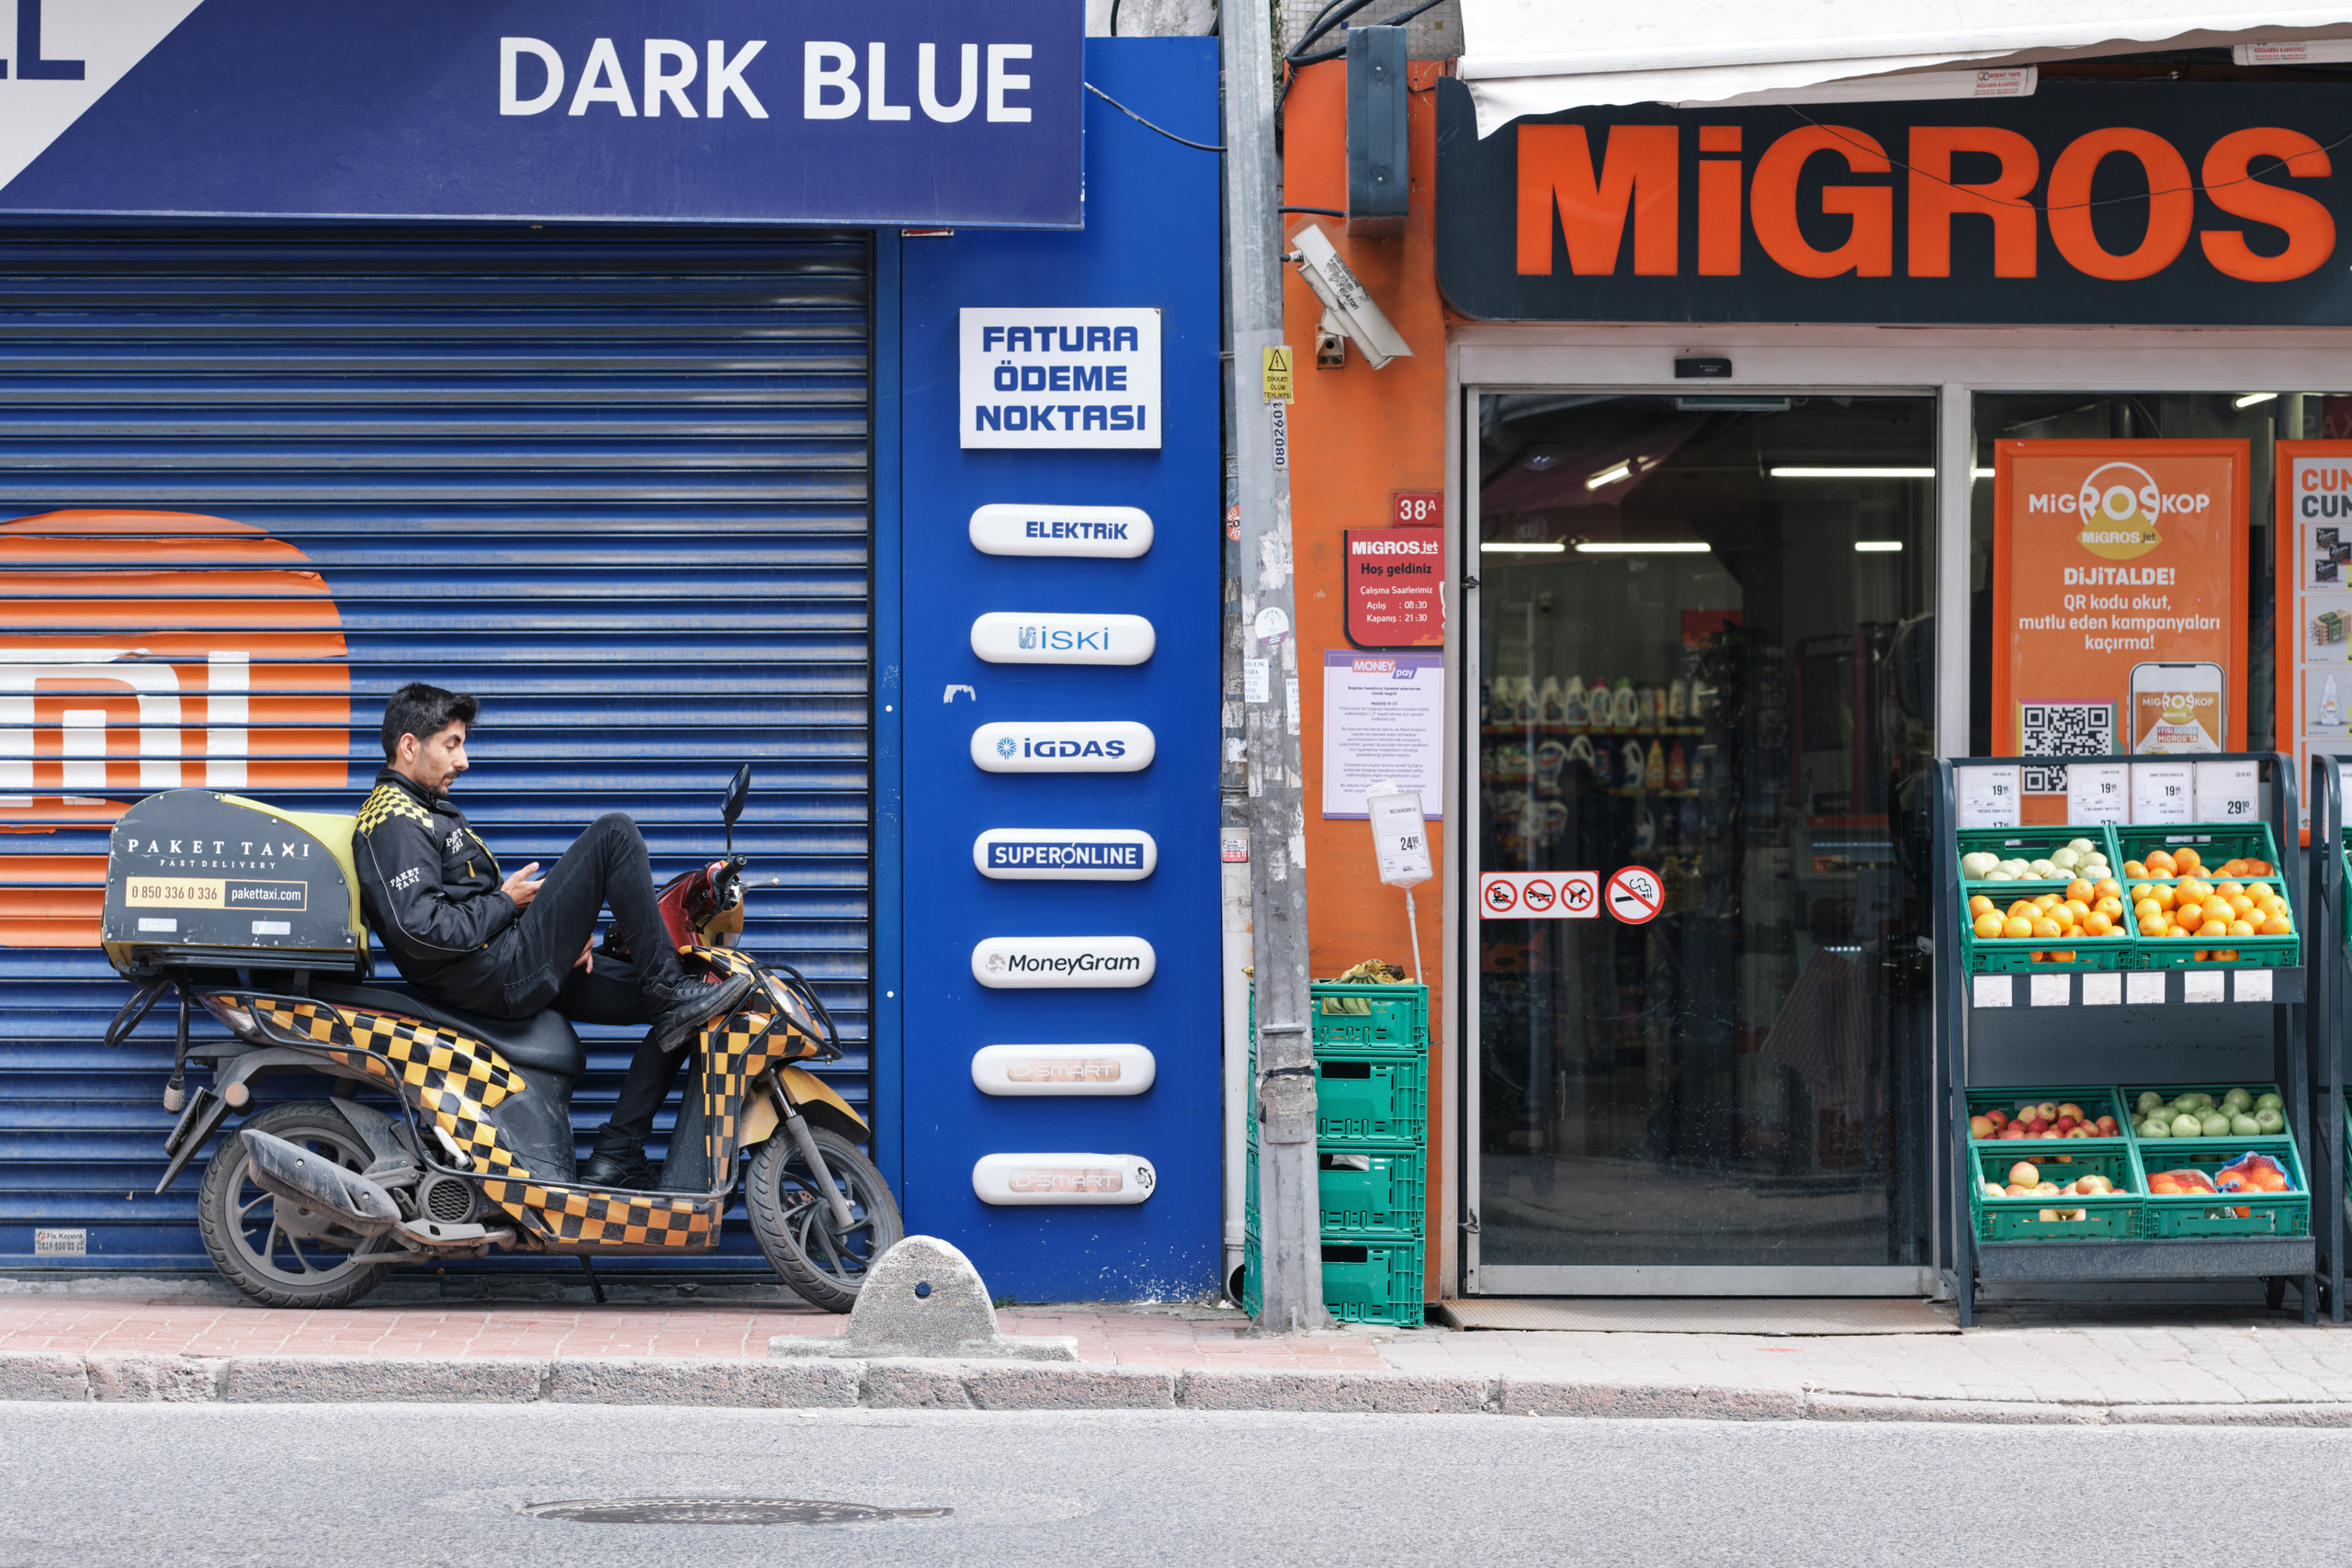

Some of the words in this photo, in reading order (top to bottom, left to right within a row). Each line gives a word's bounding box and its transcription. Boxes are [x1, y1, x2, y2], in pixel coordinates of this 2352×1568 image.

[499, 36, 770, 118] DARK
[804, 40, 1034, 123] BLUE
[1516, 124, 2336, 283] MiGROS
[982, 325, 1138, 353] FATURA
[993, 360, 1127, 392] ÖDEME
[975, 404, 1147, 432] NOKTASI
[1361, 562, 1384, 577] Hoş
[1386, 562, 1432, 577] geldiniz
[1360, 586, 1390, 595] Çalışma
[1391, 585, 1433, 594] Saatlerimiz
[1366, 601, 1386, 611] Açılış
[2064, 594, 2086, 612] QR
[2090, 593, 2129, 610] kodu
[2132, 594, 2172, 611] okut,
[1366, 614, 1396, 624] Kapanış
[2018, 615, 2065, 629] mutlu
[2069, 615, 2108, 629] eden
[2111, 615, 2221, 633] kampanyaları
[2085, 634, 2154, 653] kaçırma!
[1353, 660, 1395, 671] MONEY
[1396, 670, 1414, 679] pay
[128, 839, 224, 854] PAKET
[241, 841, 310, 858] TAXI
[995, 844, 1137, 867] SUPERONLINE
[390, 867, 420, 887] PAKET
[396, 874, 420, 891] TAXI
[131, 886, 139, 898] 0
[141, 886, 162, 898] 850
[164, 886, 185, 898] 336
[187, 886, 195, 899] 0
[198, 886, 218, 899] 336
[232, 886, 301, 901] pakettaxi.com
[1008, 953, 1140, 976] MoneyGram
[1013, 1065, 1115, 1077] D-SMART
[1015, 1174, 1116, 1188] D-SMART
